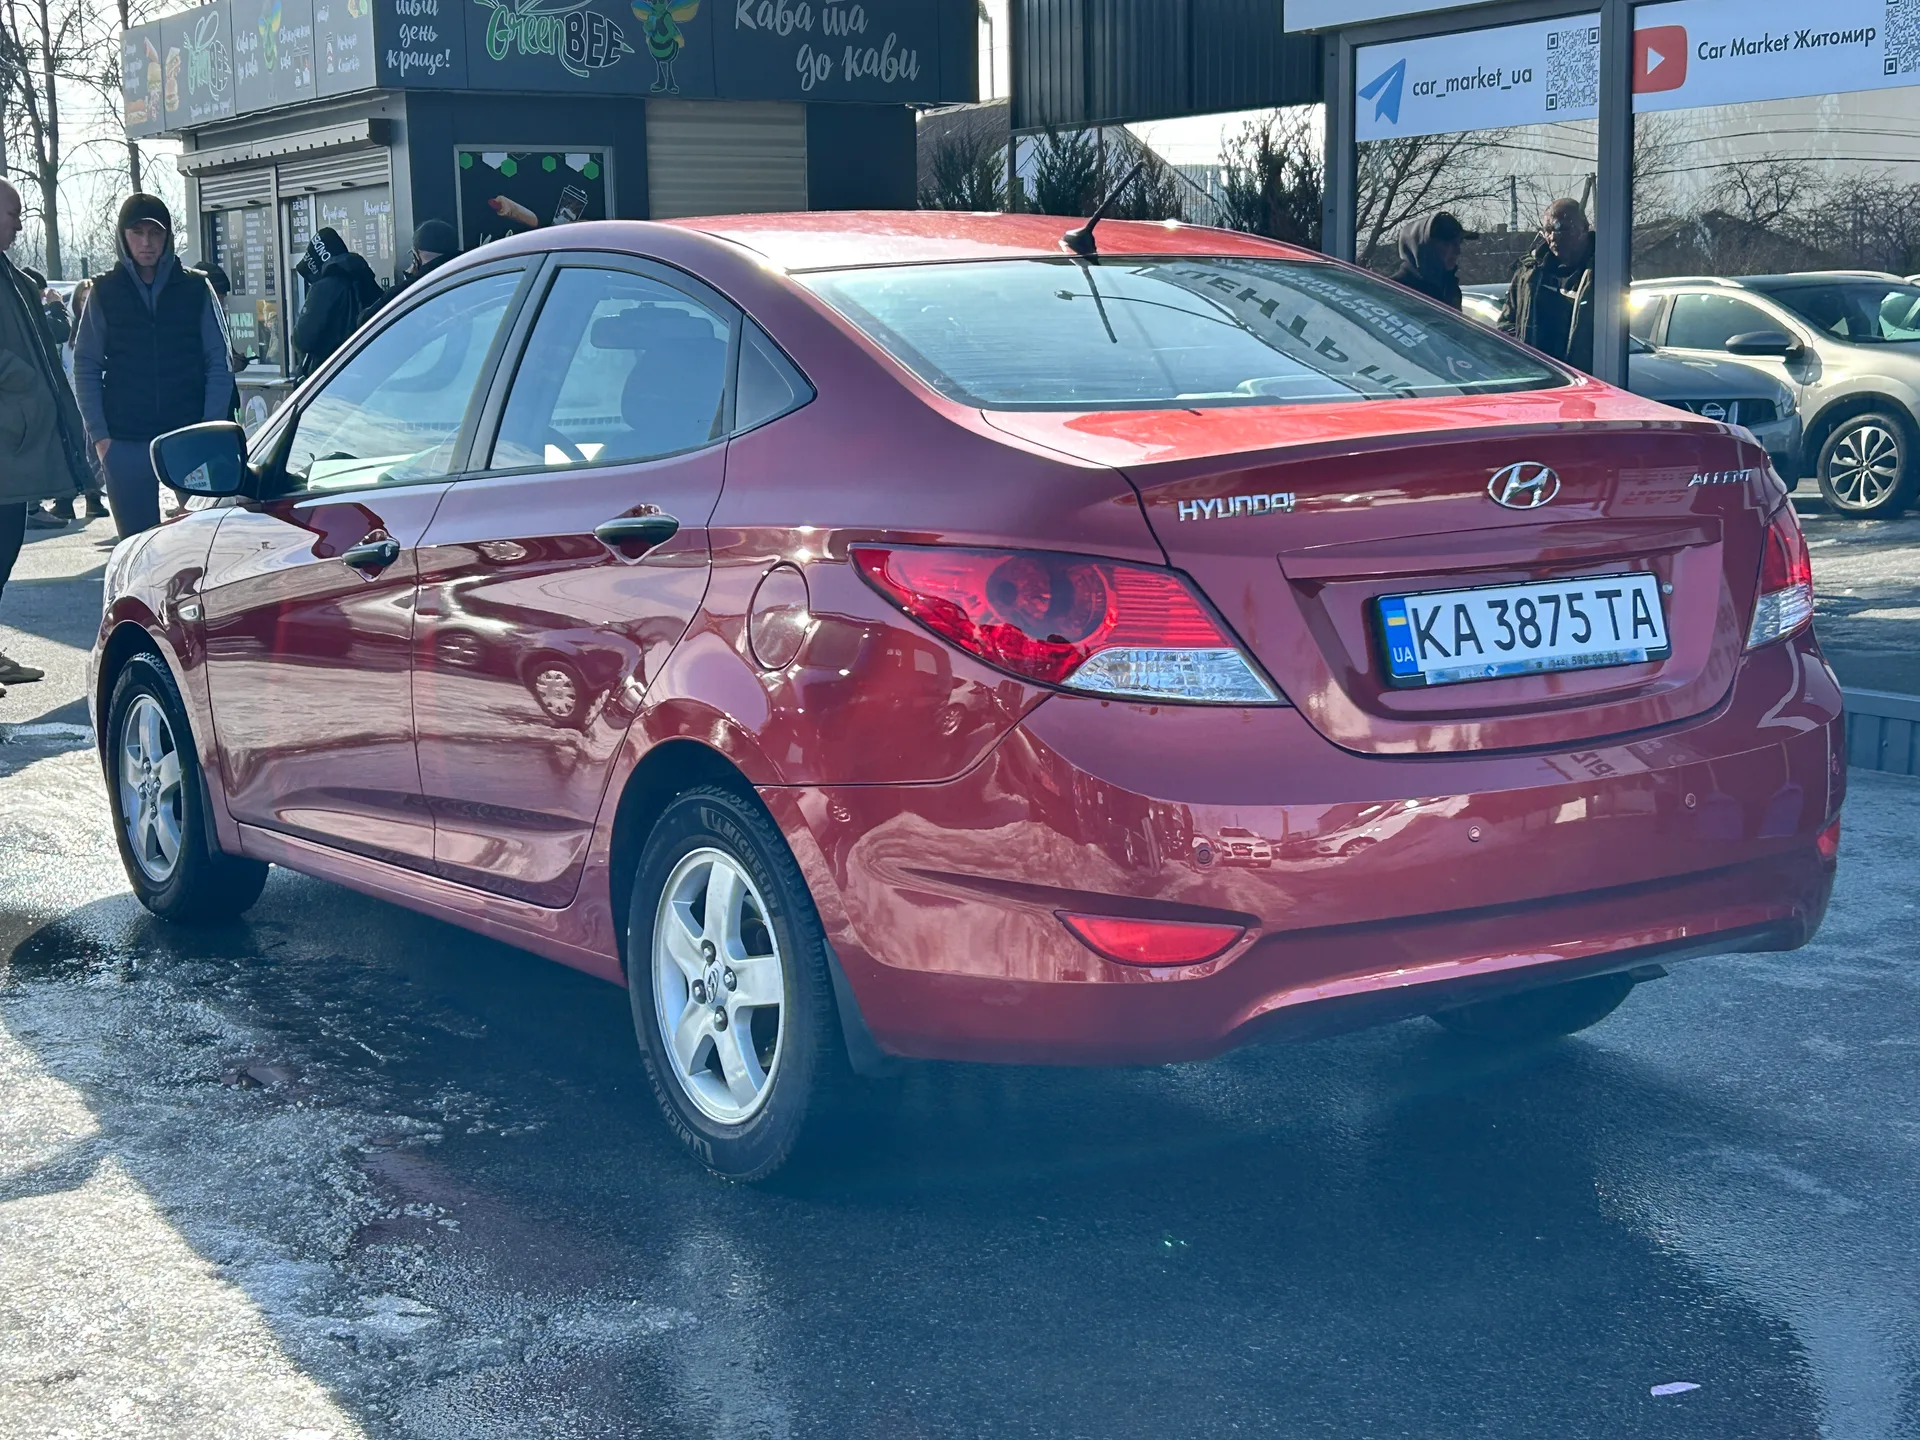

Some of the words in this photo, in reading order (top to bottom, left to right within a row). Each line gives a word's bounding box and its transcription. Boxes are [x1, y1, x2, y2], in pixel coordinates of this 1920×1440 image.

[735, 0, 816, 37] Кава
[399, 23, 439, 48] день
[1697, 41, 1727, 60] Car
[1730, 32, 1790, 57] Market
[1793, 27, 1877, 50] Житомир
[385, 48, 451, 78] краще!
[796, 43, 834, 91] до
[841, 32, 921, 83] кави
[1412, 66, 1532, 98] car_market_ua
[1178, 492, 1295, 521] HYUNDAI
[1411, 604, 1484, 660] KA
[1487, 592, 1592, 651] 3875
[1595, 588, 1658, 641] TA
[1393, 647, 1414, 663] UA
[722, 822, 779, 910] MICHELIN
